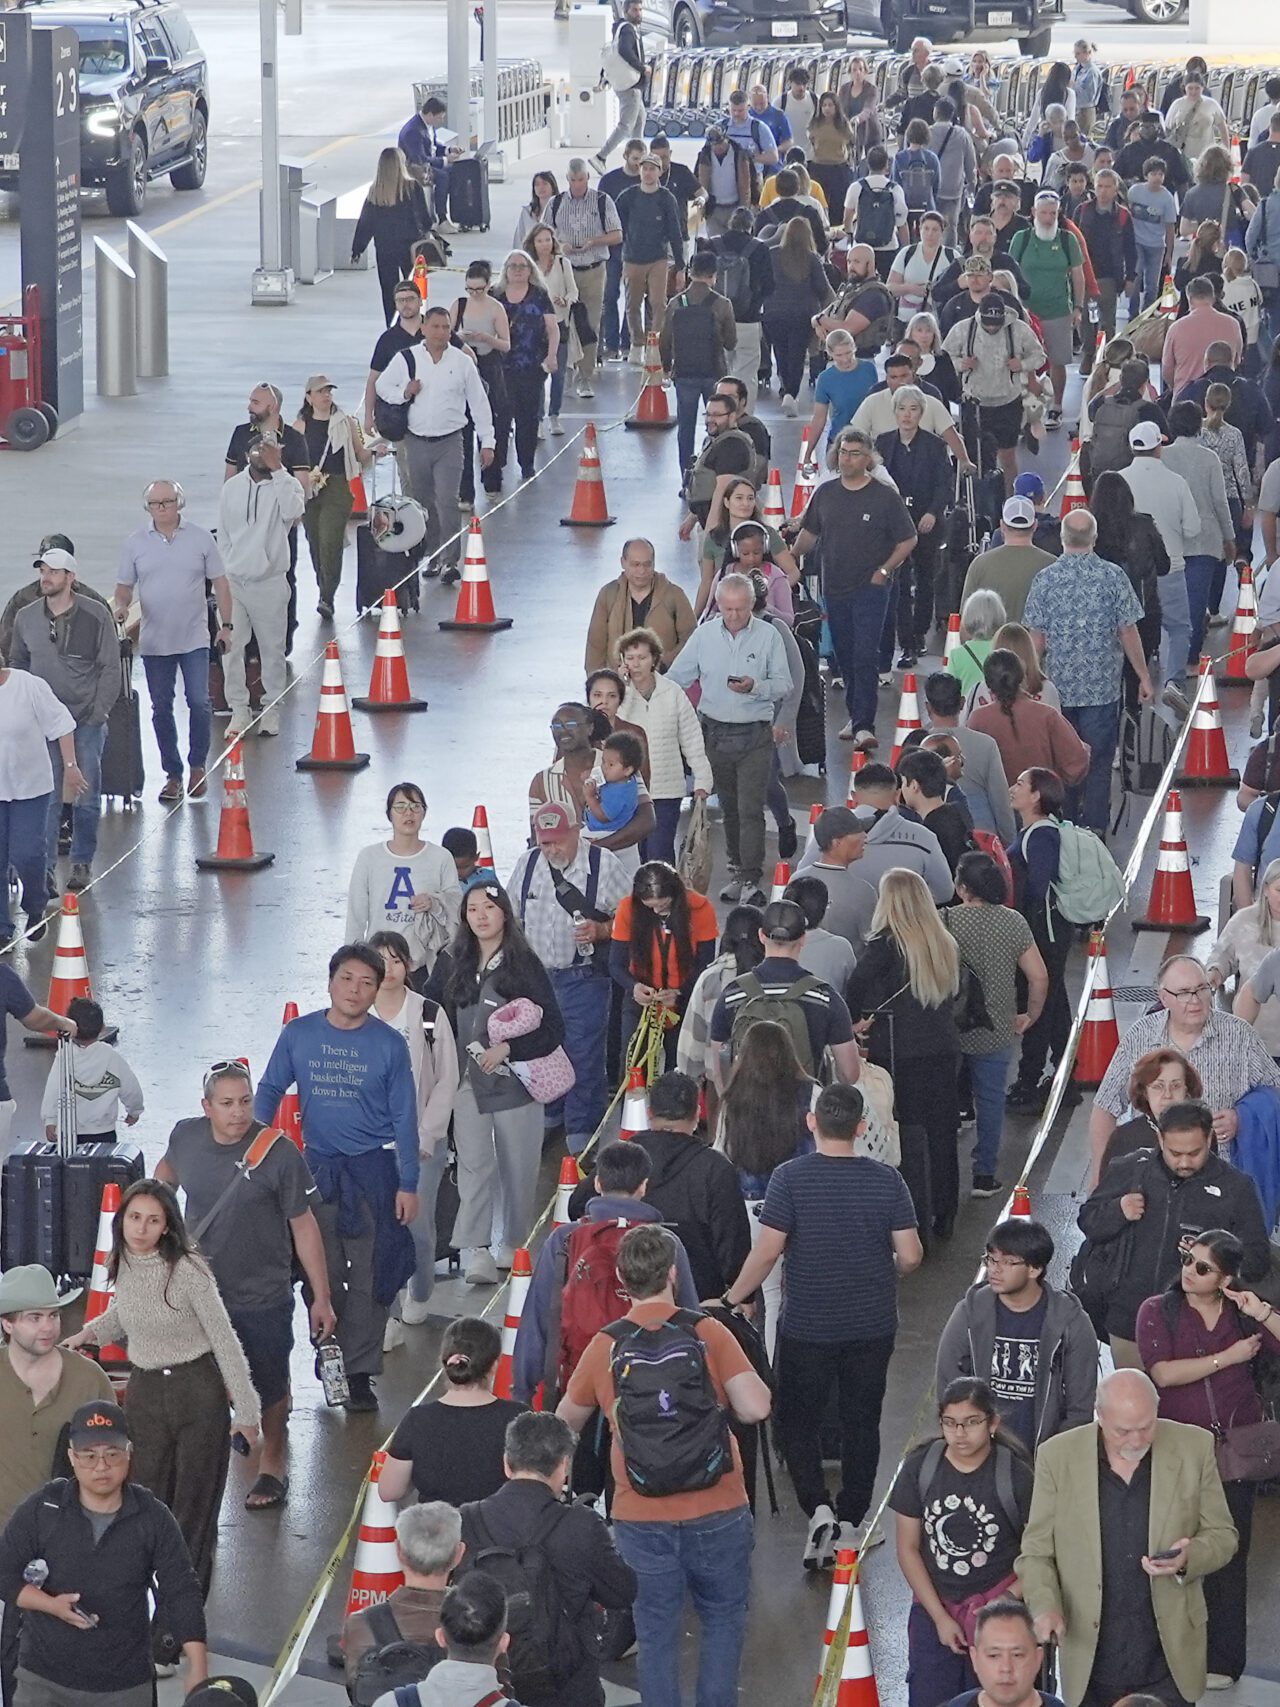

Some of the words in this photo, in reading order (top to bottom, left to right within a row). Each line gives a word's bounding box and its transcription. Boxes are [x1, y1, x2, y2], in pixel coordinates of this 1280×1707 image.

[56, 71, 65, 117] 2
[69, 67, 77, 113] 3
[385, 867, 415, 909] A
[320, 1043, 348, 1057] There
[350, 1047, 360, 1058] is
[308, 1060, 321, 1069] no
[323, 1060, 368, 1074] intelligent
[310, 1072, 364, 1086] basketballer
[311, 1086, 337, 1098] down
